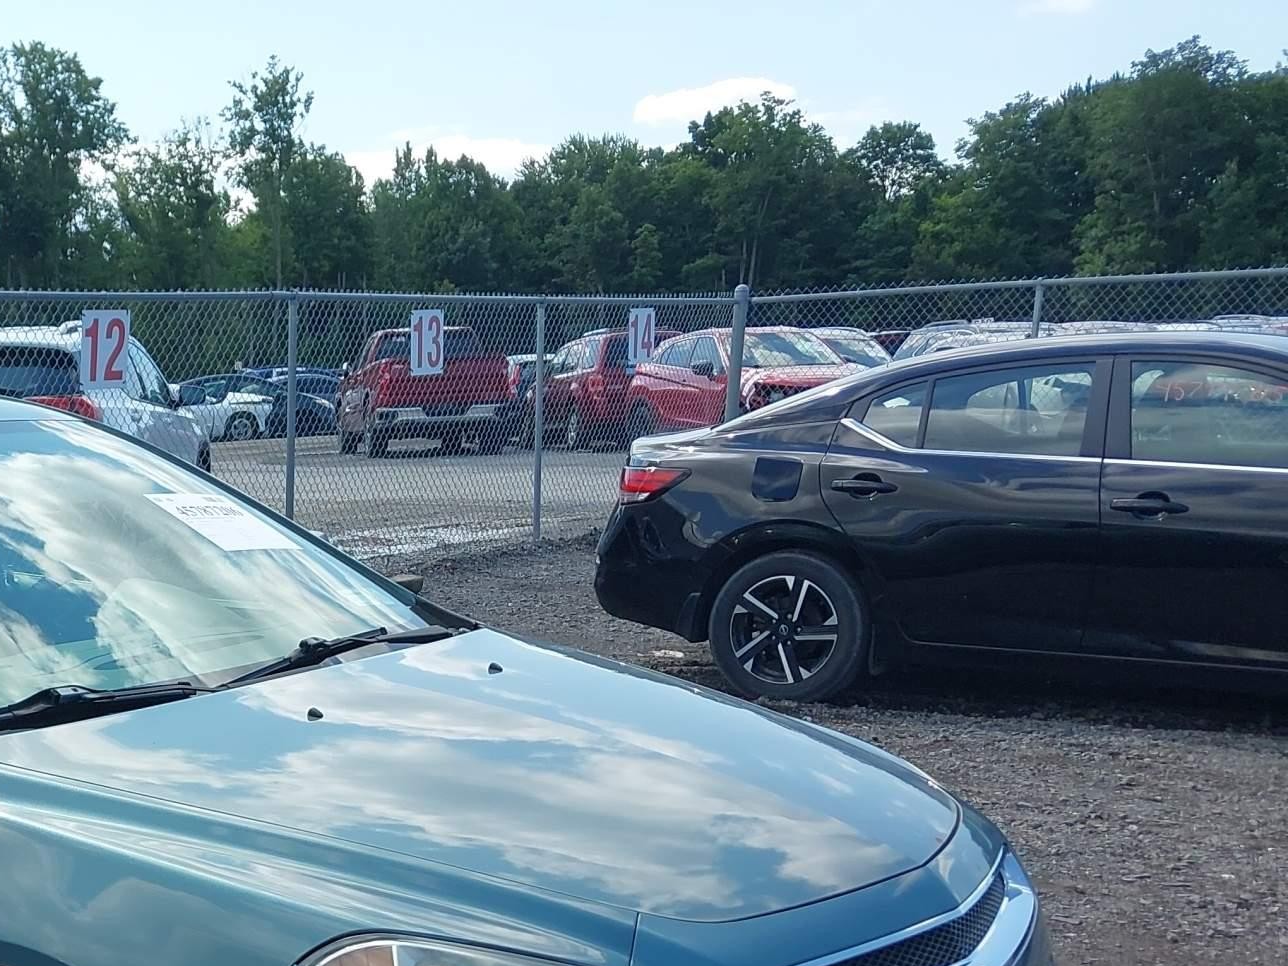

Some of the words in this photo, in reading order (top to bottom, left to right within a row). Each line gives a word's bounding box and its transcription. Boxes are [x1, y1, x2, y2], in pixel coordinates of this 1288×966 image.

[85, 318, 125, 381] 12
[413, 315, 441, 368] 13
[631, 313, 652, 359] 14
